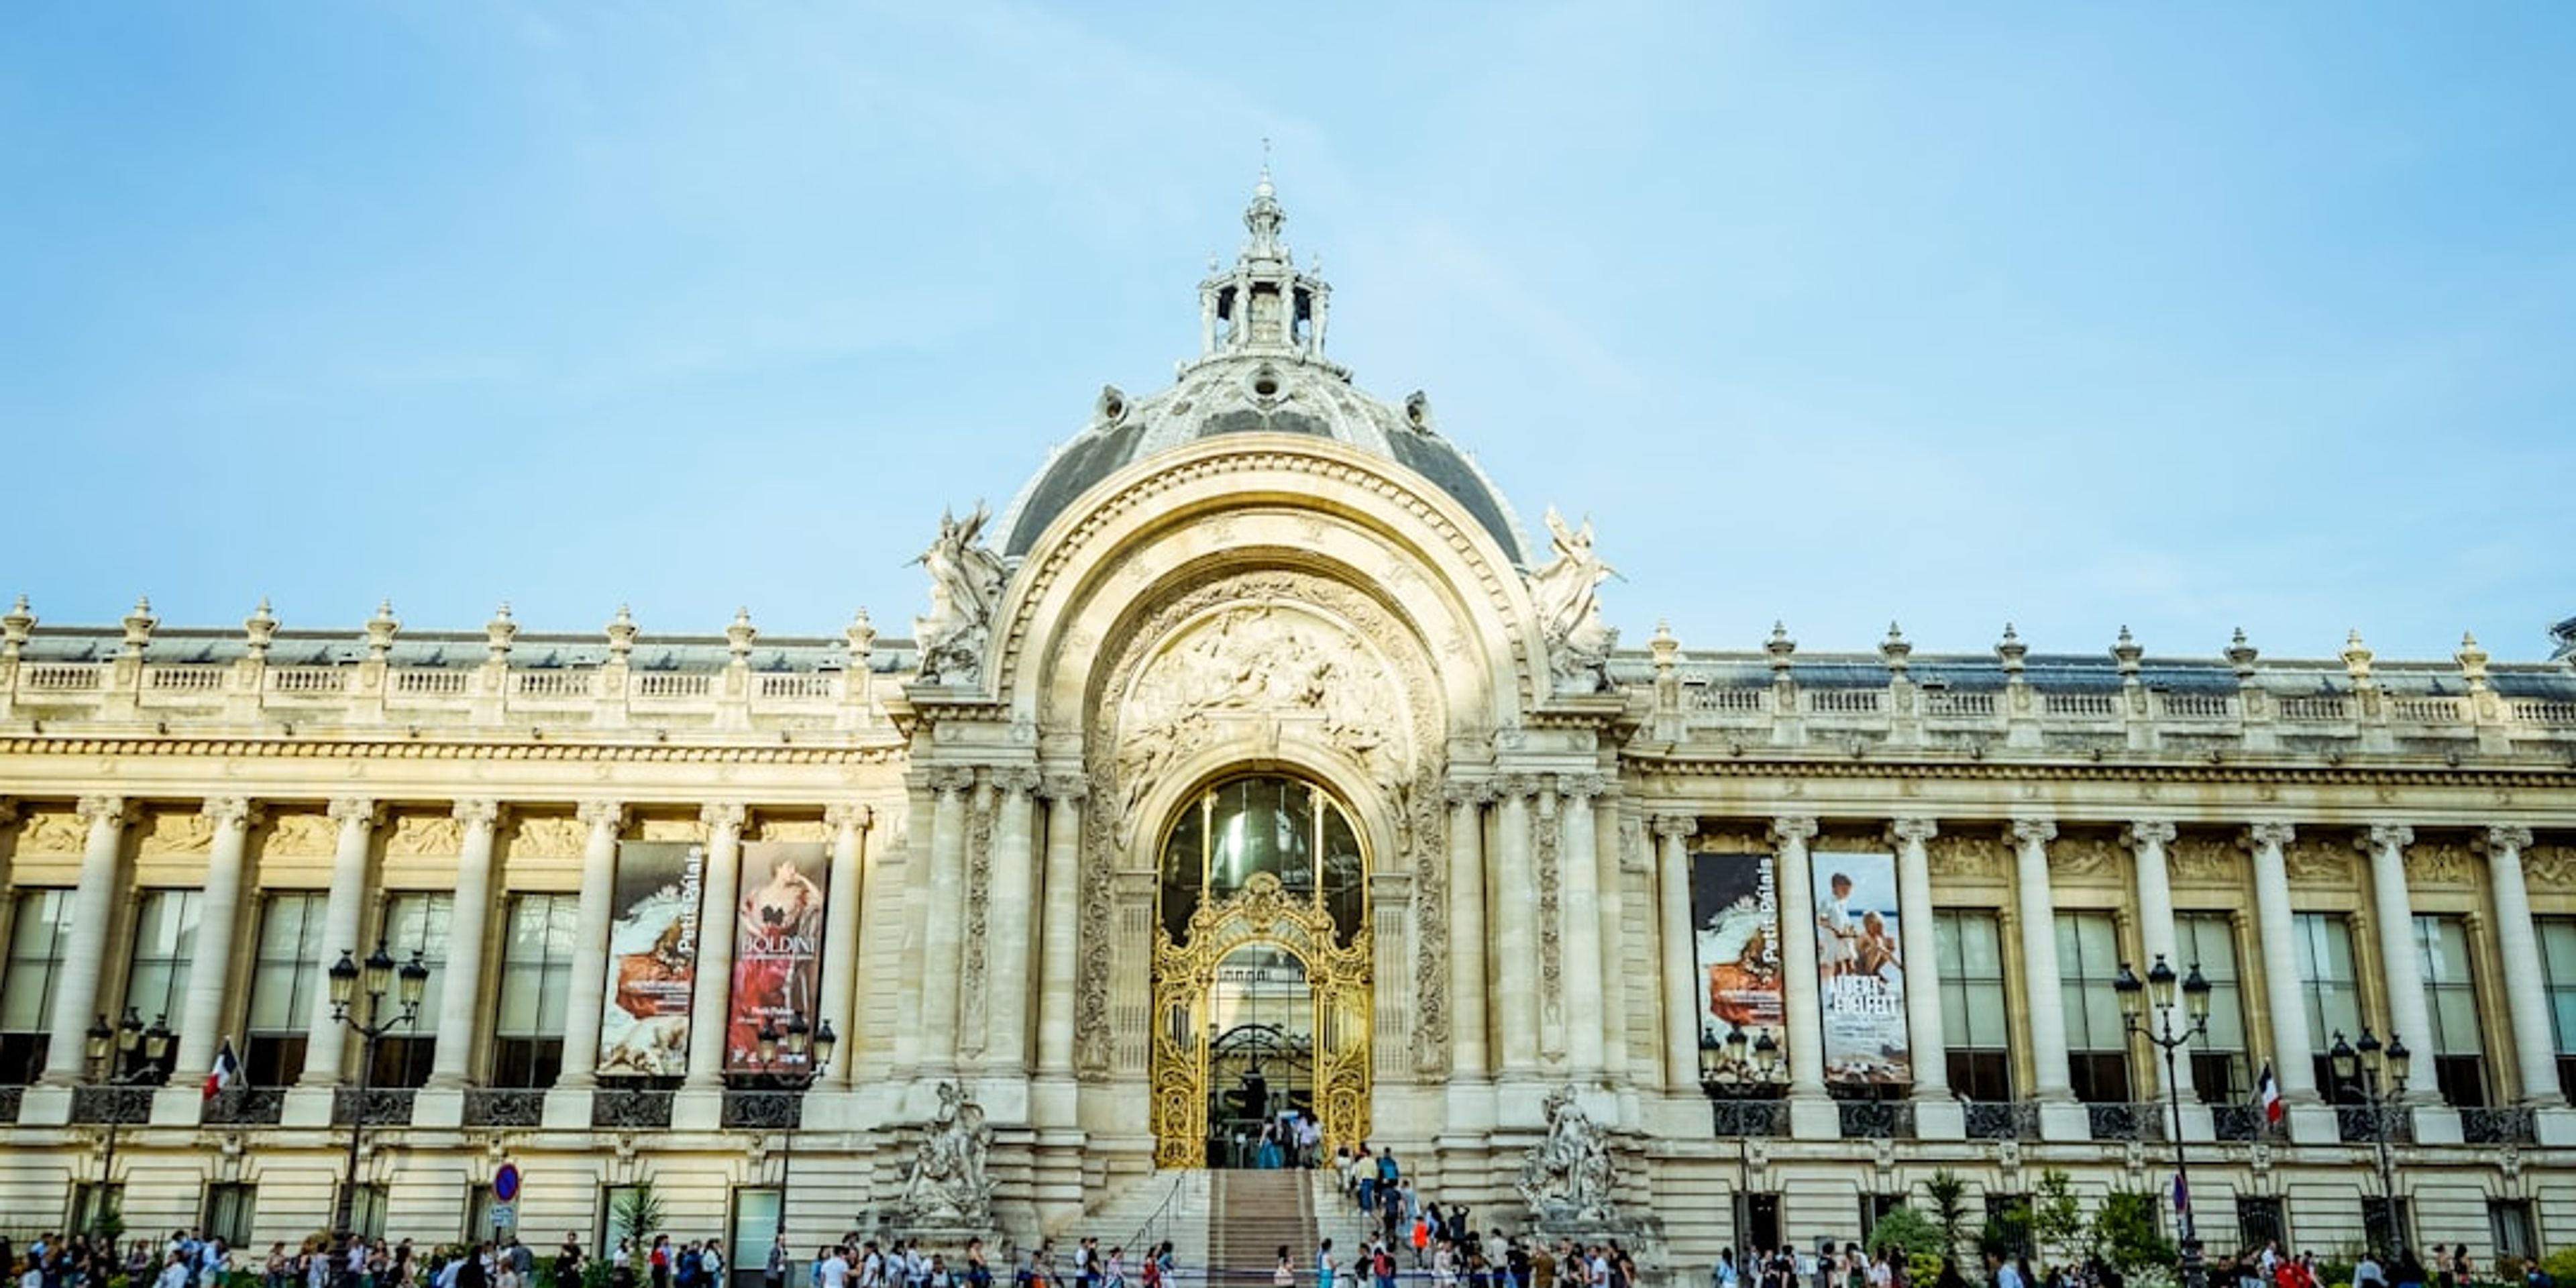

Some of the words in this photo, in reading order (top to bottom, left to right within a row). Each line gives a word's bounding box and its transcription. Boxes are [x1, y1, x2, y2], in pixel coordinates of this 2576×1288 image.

[678, 909, 698, 953] Petit
[741, 935, 815, 953] BOLDINI
[1761, 919, 1778, 963] Petit
